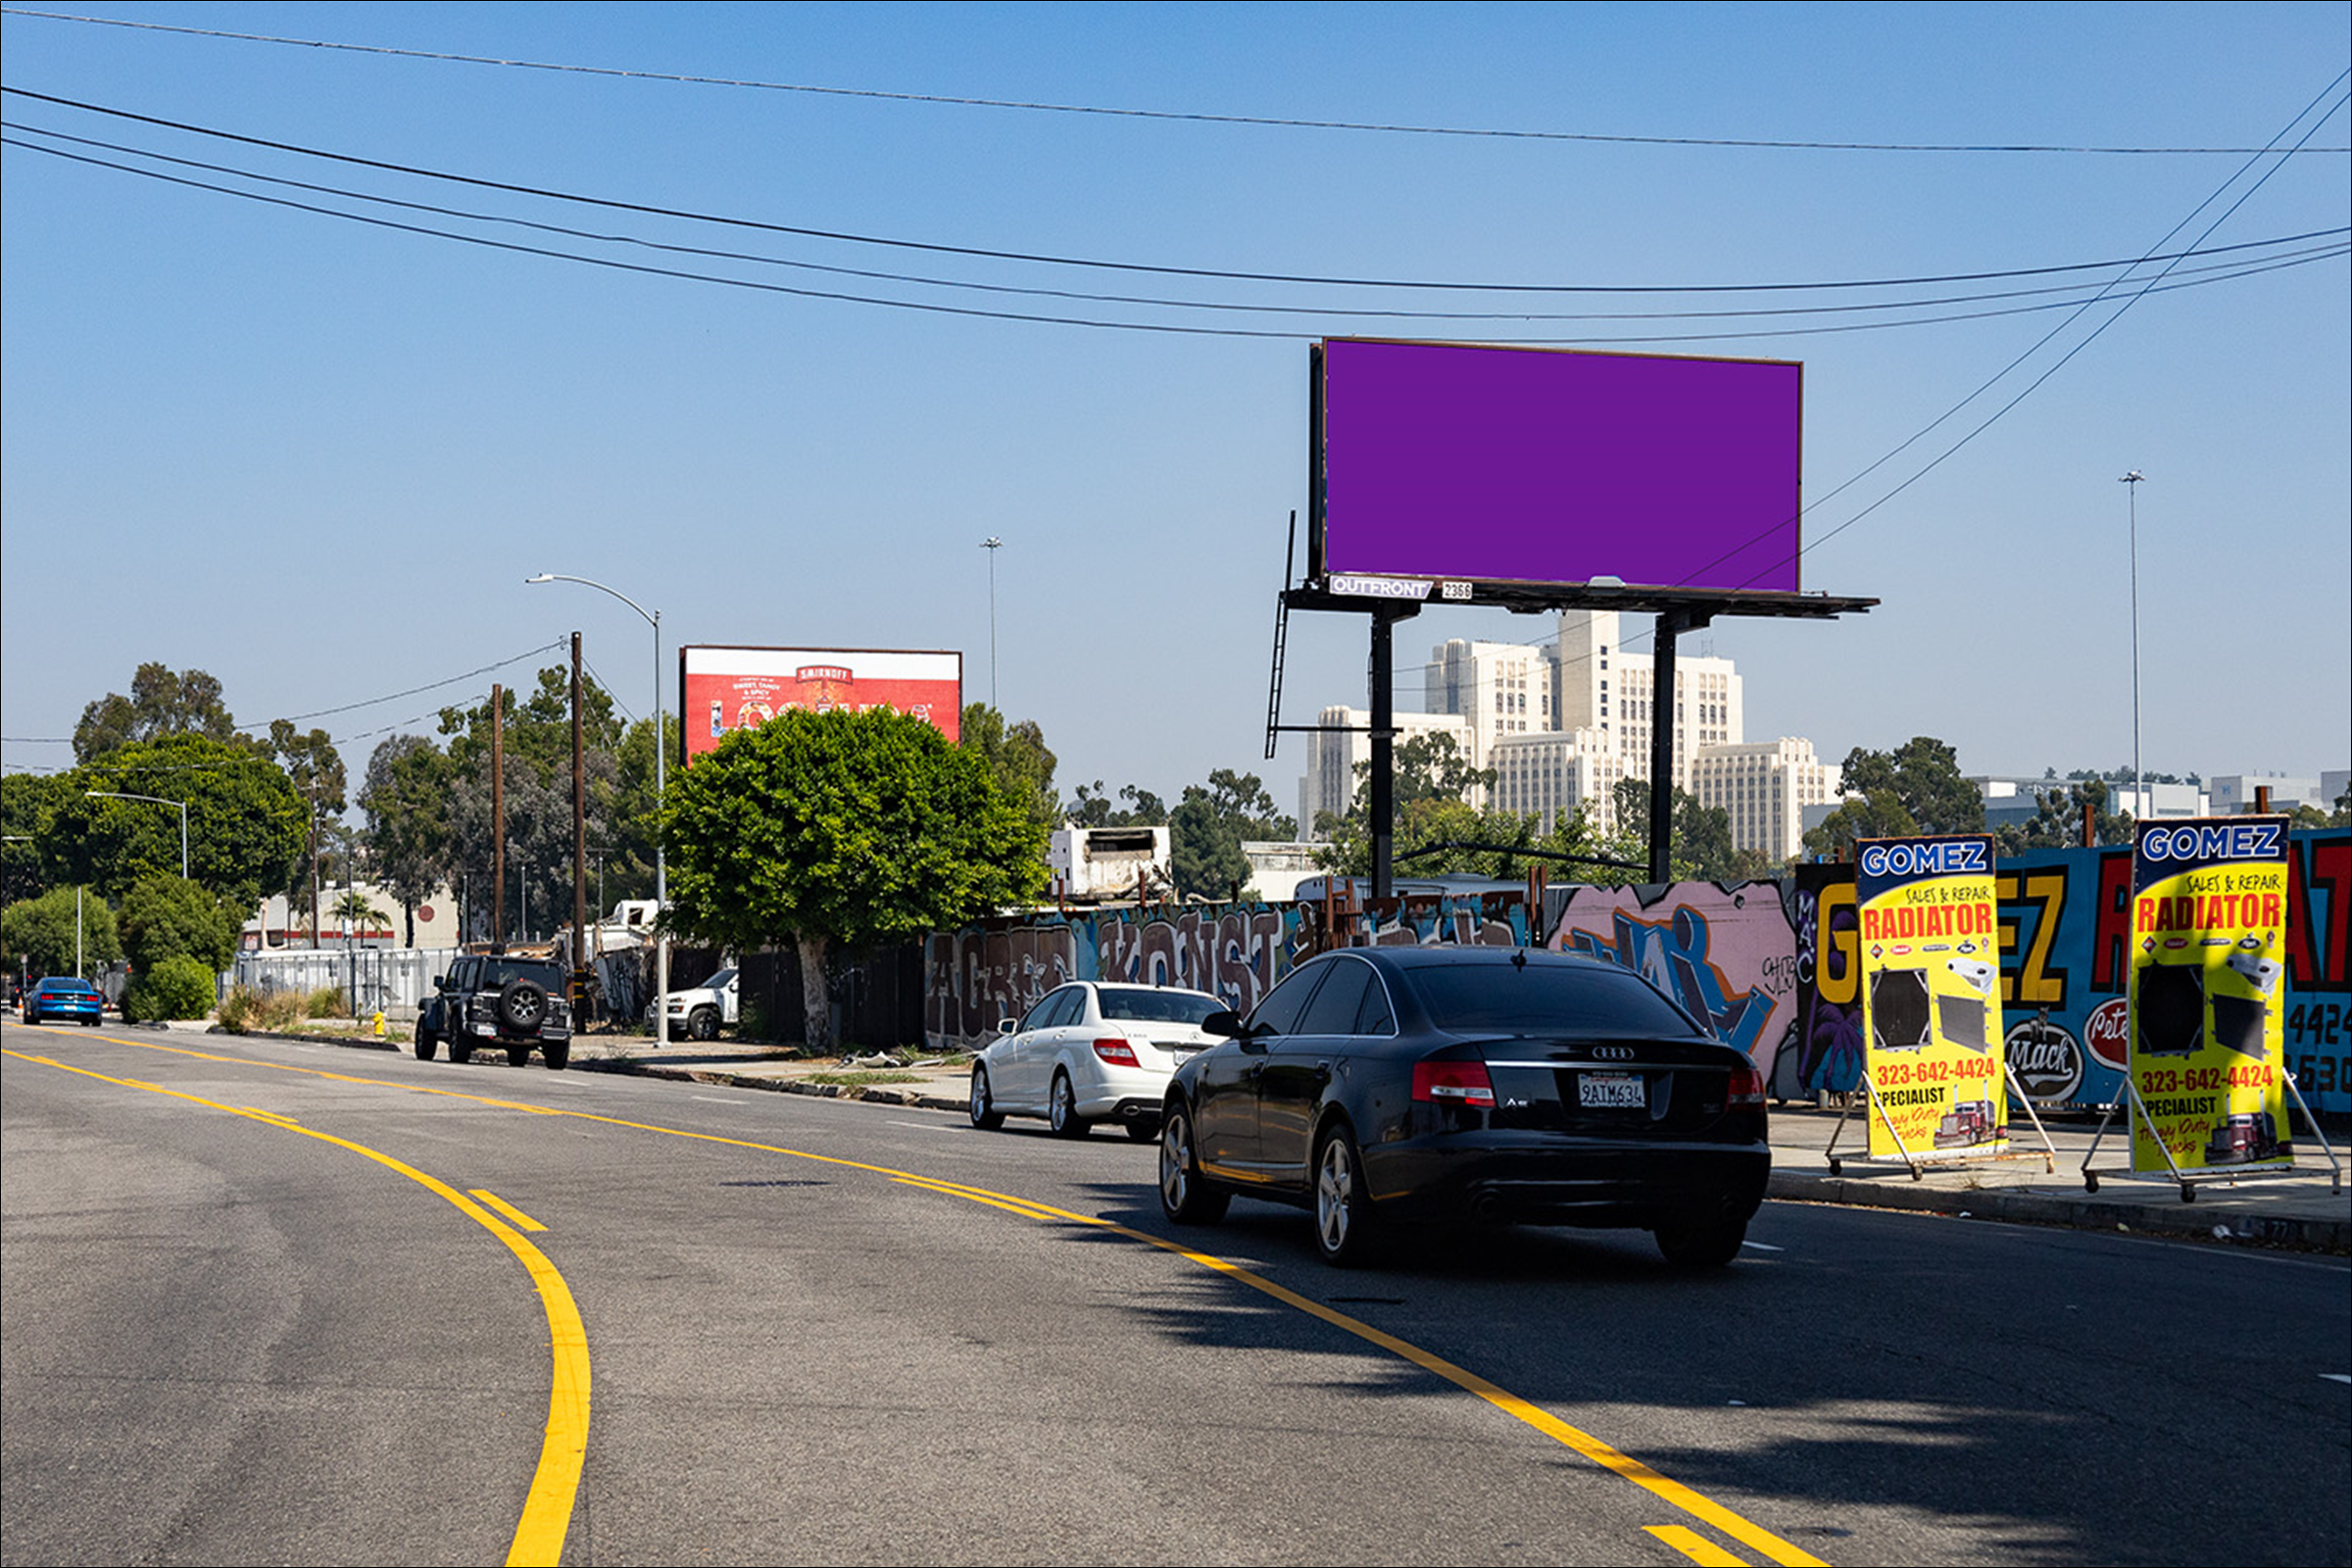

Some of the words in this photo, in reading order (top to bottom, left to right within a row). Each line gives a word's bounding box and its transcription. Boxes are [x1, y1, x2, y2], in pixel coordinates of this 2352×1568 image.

[1333, 577, 1426, 597] OUTFRONT
[800, 667, 849, 680] SMIRNOFF
[2142, 824, 2280, 861] GOMEZ
[1861, 841, 1986, 876] GOMEZ
[1906, 887, 1936, 905] SALES
[1940, 887, 1948, 904] &
[1952, 886, 1991, 902] REPAIR
[2186, 874, 2220, 894] SALES
[2225, 874, 2234, 892] &
[2238, 873, 2281, 891] REPAIR
[1864, 904, 1992, 940] RADIATOR
[2137, 893, 2281, 932] RADIATOR
[2008, 1034, 2072, 1072] Mack
[1878, 1057, 1996, 1086] 323-642-4424
[2141, 1064, 2274, 1094] 323-642-4424
[1581, 1084, 1643, 1103] 9ATM634
[1875, 1113, 1909, 1128] Havy
[1911, 1106, 1940, 1123] Duty
[2138, 1124, 2176, 1142] Havy
[2179, 1117, 2211, 1136] Duty
